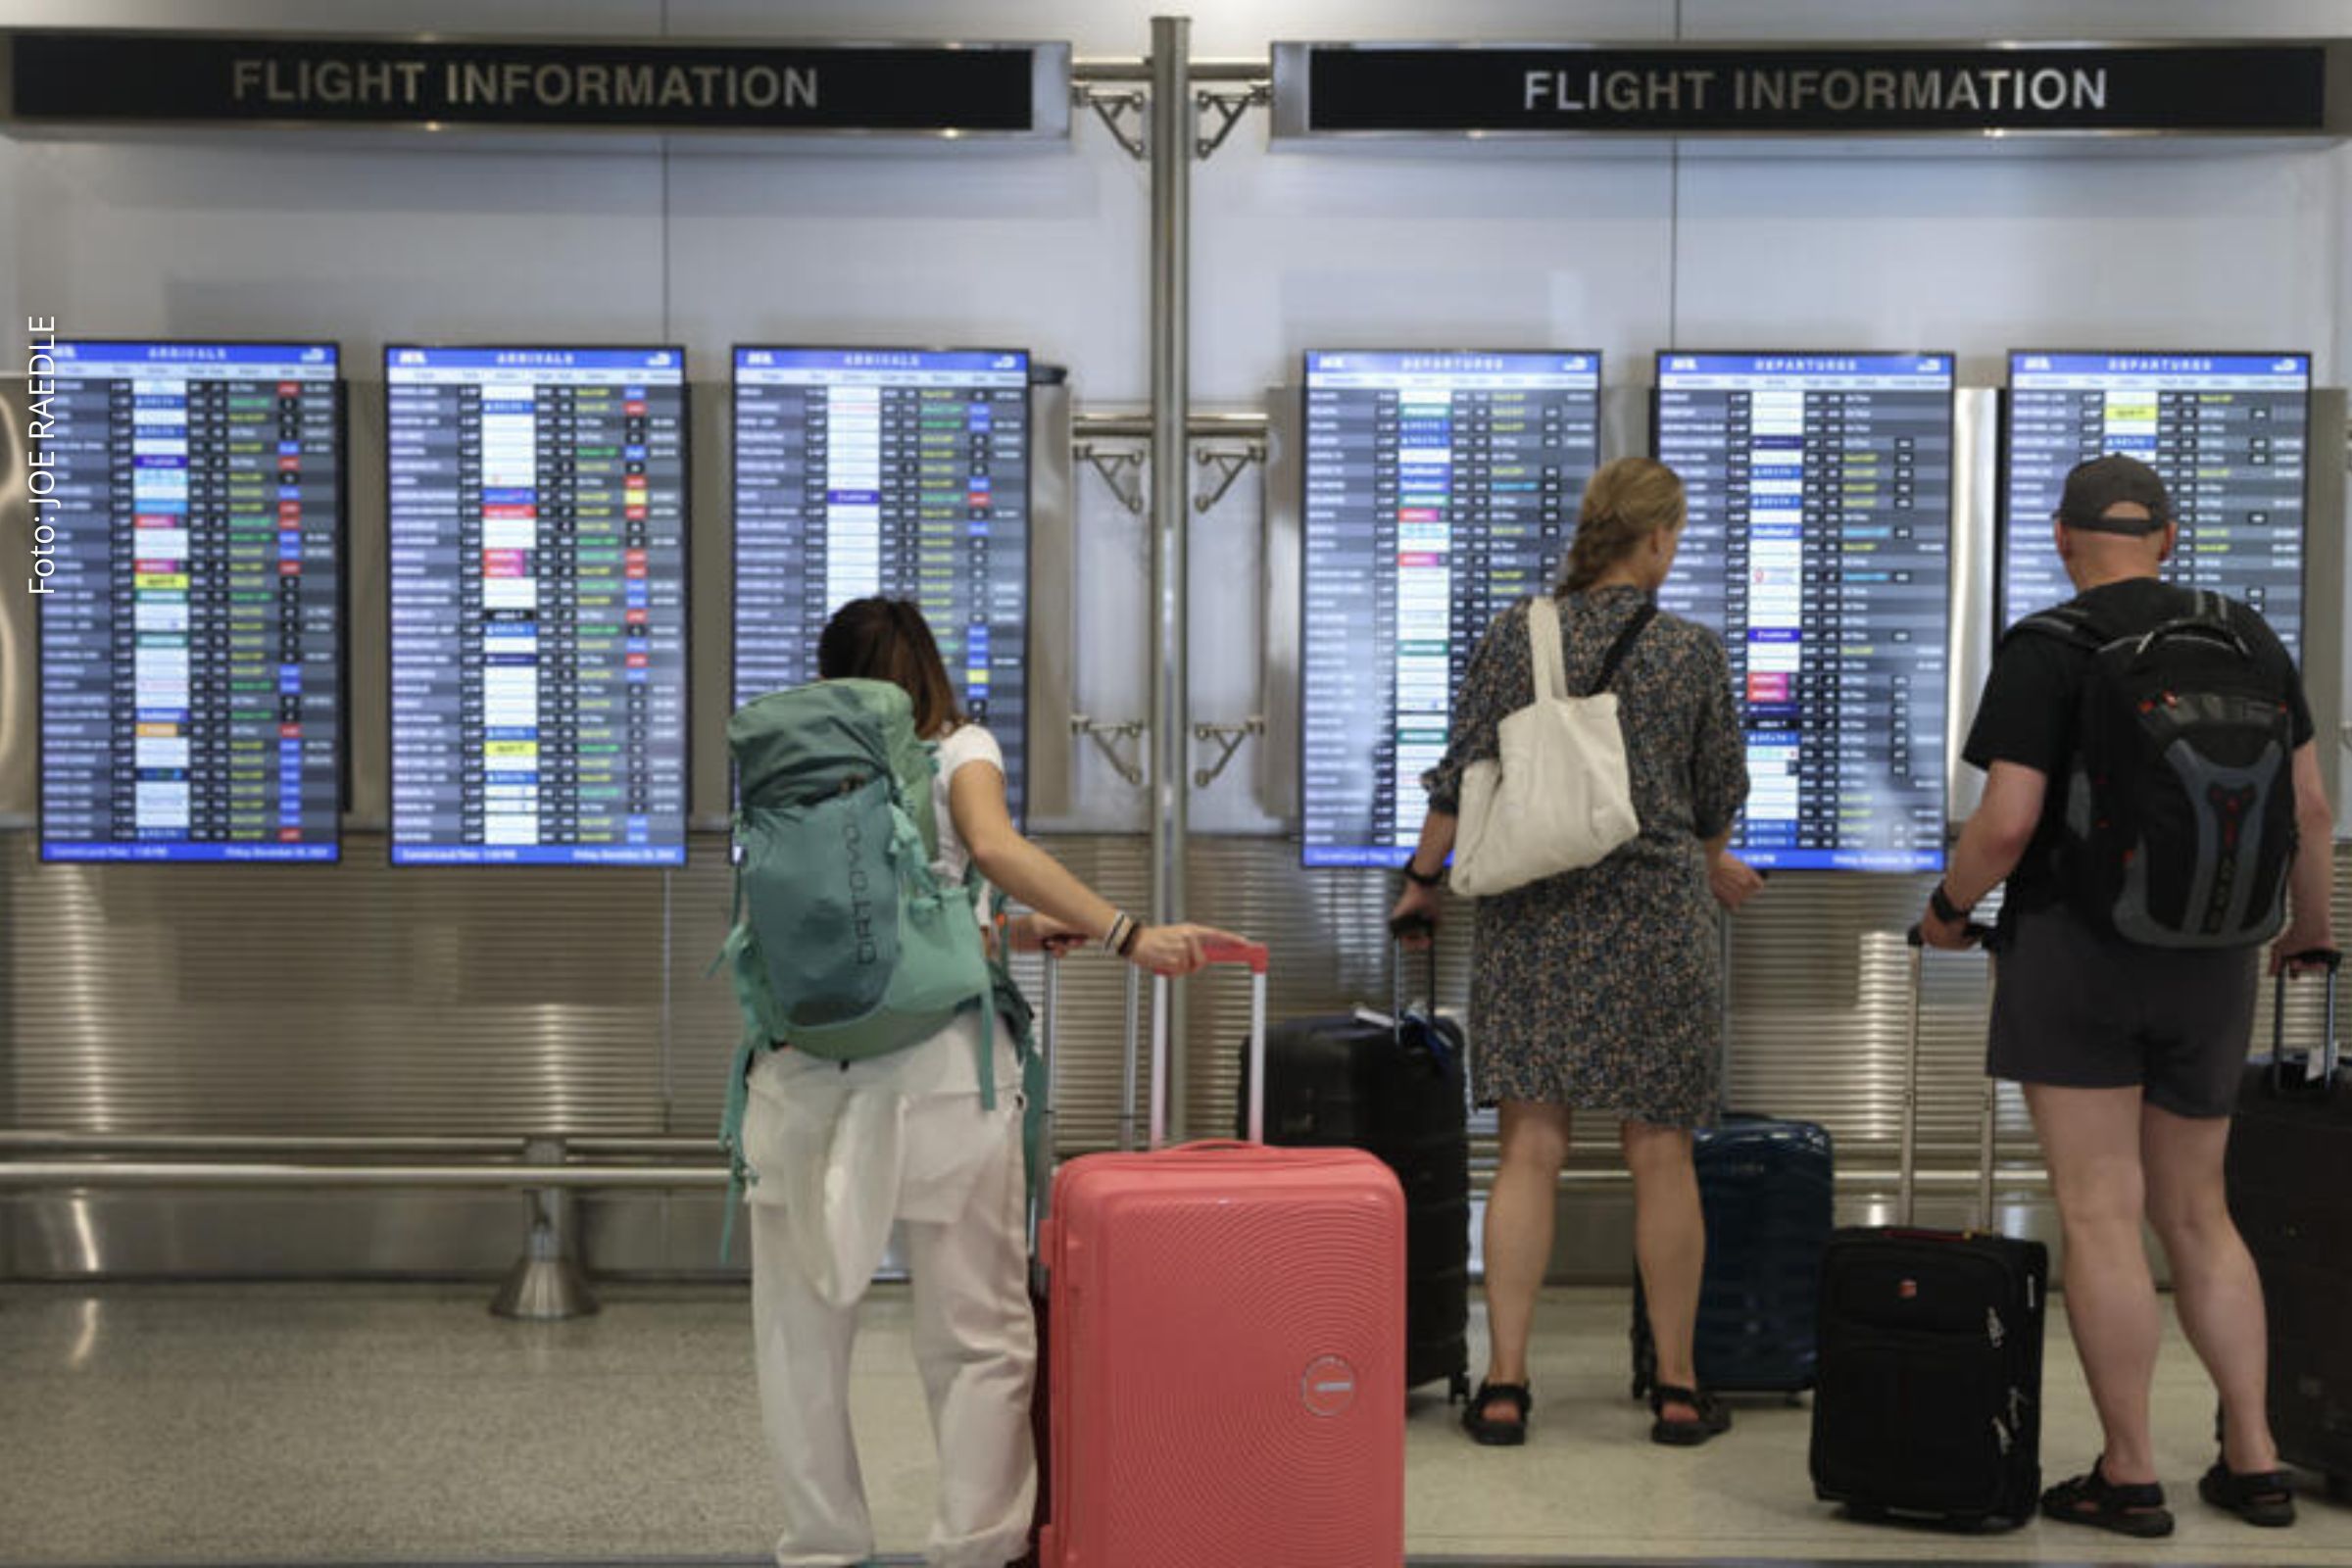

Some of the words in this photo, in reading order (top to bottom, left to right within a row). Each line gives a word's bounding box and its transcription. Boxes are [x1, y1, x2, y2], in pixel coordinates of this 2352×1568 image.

[232, 59, 426, 103] FLIGHT
[446, 61, 818, 108] INFORMATION
[1524, 70, 1714, 110] FLIGHT
[1734, 68, 2108, 111] INFORMATION
[148, 348, 226, 360] ARRIVALS
[496, 353, 574, 365] ARRIVALS
[844, 354, 920, 366] ARRIVALS
[1401, 358, 1503, 369] DEPARTURES
[1754, 359, 1857, 370] DEPARTURES
[2108, 359, 2212, 370] DEPARTURES
